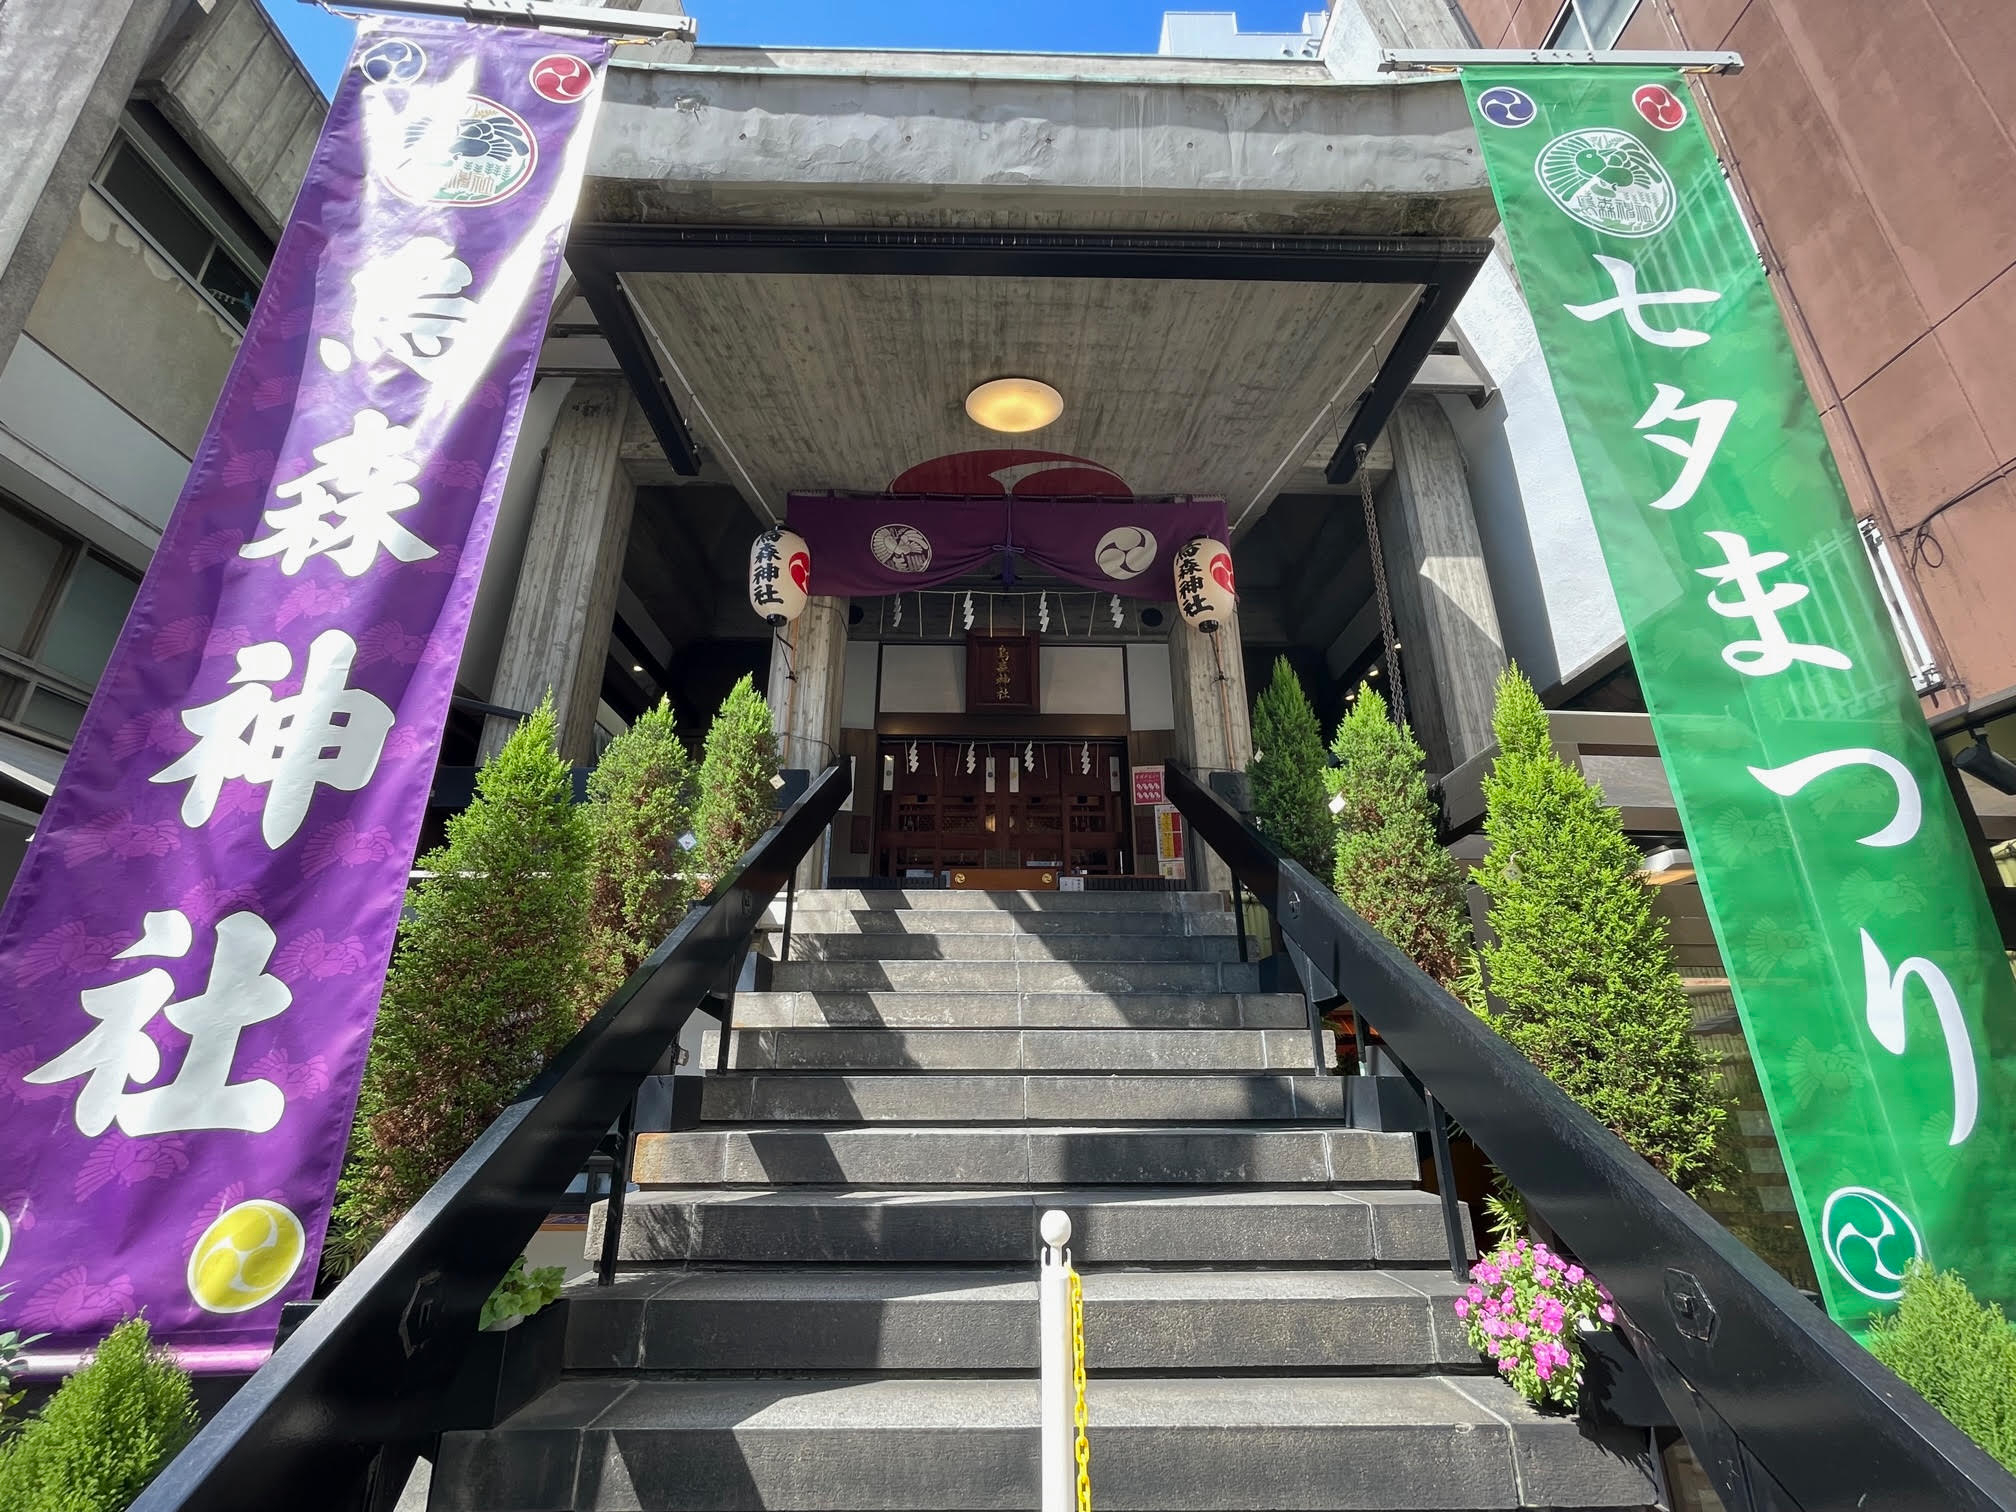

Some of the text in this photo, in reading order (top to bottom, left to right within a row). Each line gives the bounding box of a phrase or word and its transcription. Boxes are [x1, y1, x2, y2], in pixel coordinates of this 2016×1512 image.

[753, 529, 784, 606] 烏森神社
[1175, 542, 1215, 618] 烏森神社
[1564, 255, 1977, 1145] 七夕まつり
